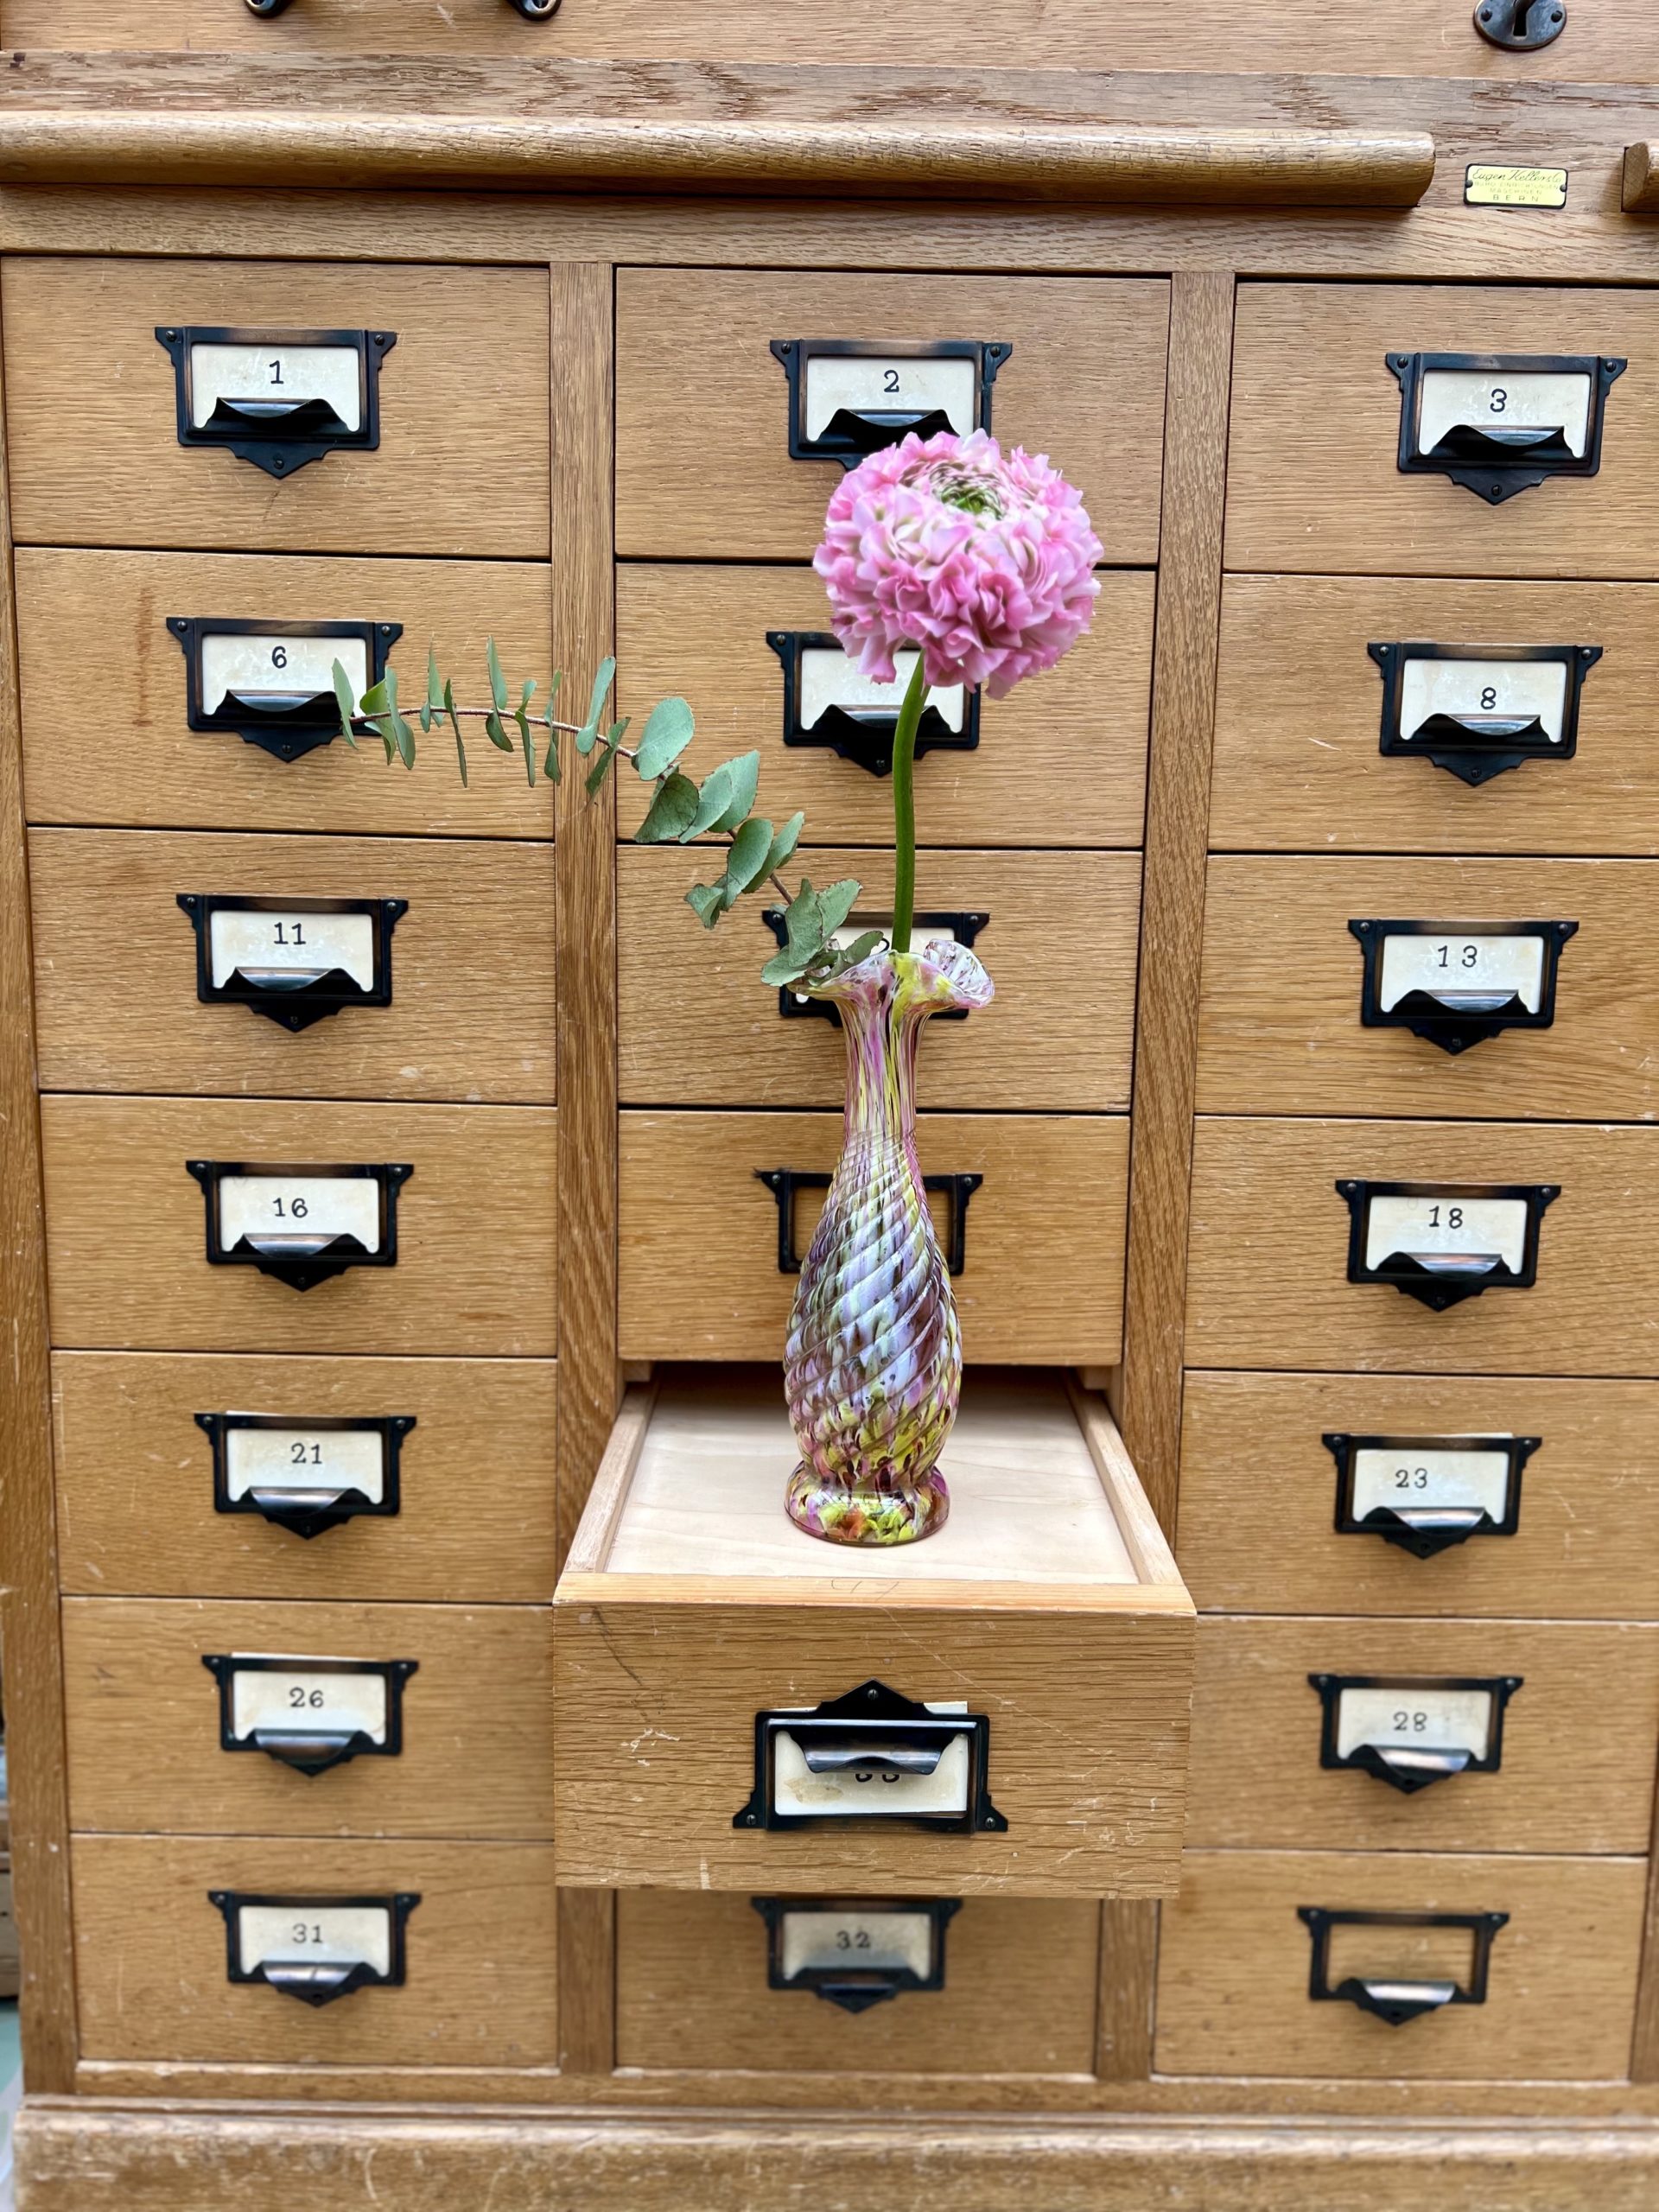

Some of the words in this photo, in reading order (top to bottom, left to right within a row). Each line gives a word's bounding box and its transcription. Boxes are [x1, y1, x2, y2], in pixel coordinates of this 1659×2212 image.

[1473, 168, 1506, 181] Eugen
[269, 359, 284, 385] 1
[883, 369, 899, 393] 2
[1490, 388, 1508, 413] 3
[271, 645, 288, 669] 6
[1480, 686, 1497, 710] 8
[273, 922, 307, 945] 11
[1437, 944, 1478, 968] 13
[272, 1198, 308, 1219] 16
[1428, 1205, 1463, 1230] 18
[291, 1442, 322, 1465] 21
[1395, 1467, 1427, 1489] 23
[289, 1687, 323, 1708] 26
[1394, 1712, 1427, 1732] 28
[292, 1925, 323, 1944] 31
[836, 1929, 871, 1952] 32
